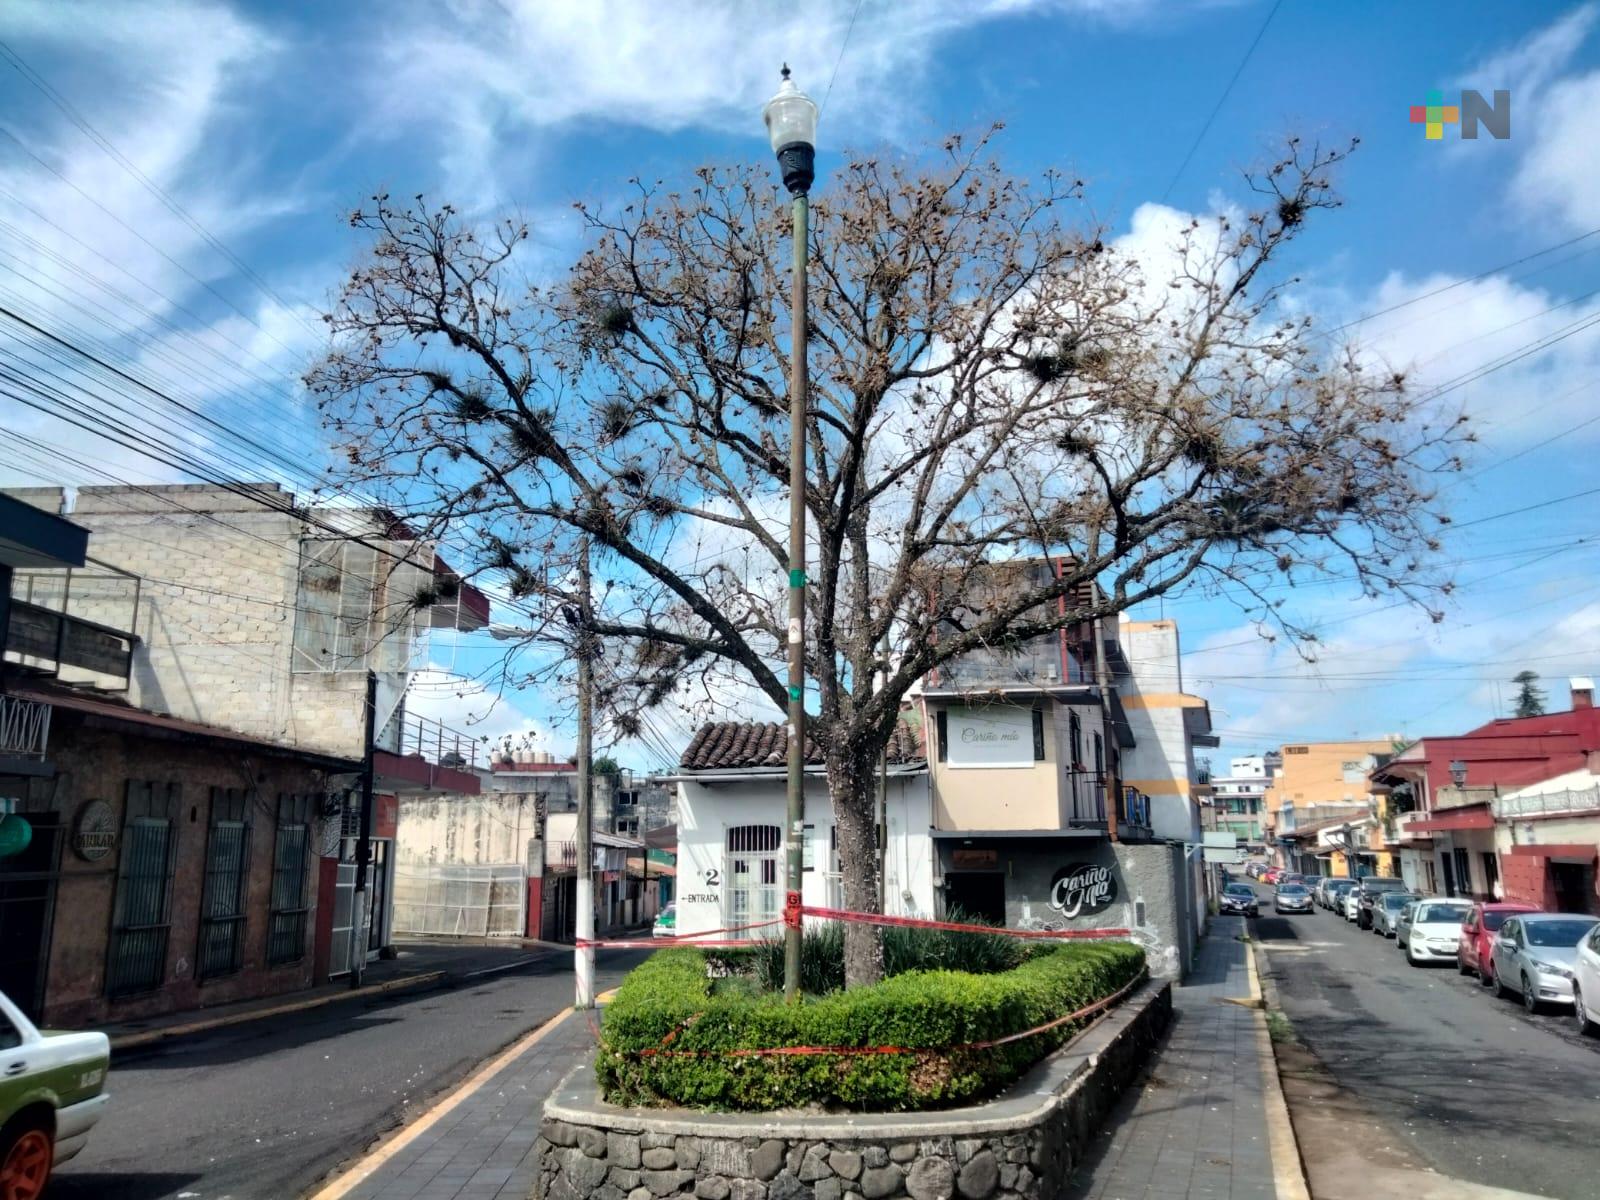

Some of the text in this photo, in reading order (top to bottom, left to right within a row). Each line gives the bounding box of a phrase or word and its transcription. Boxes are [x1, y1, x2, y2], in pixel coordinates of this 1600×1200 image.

[961, 727, 998, 744] Cariño
[706, 868, 720, 886] 2
[1051, 867, 1107, 909] Cariño
[688, 893, 719, 904] ENTRADA
